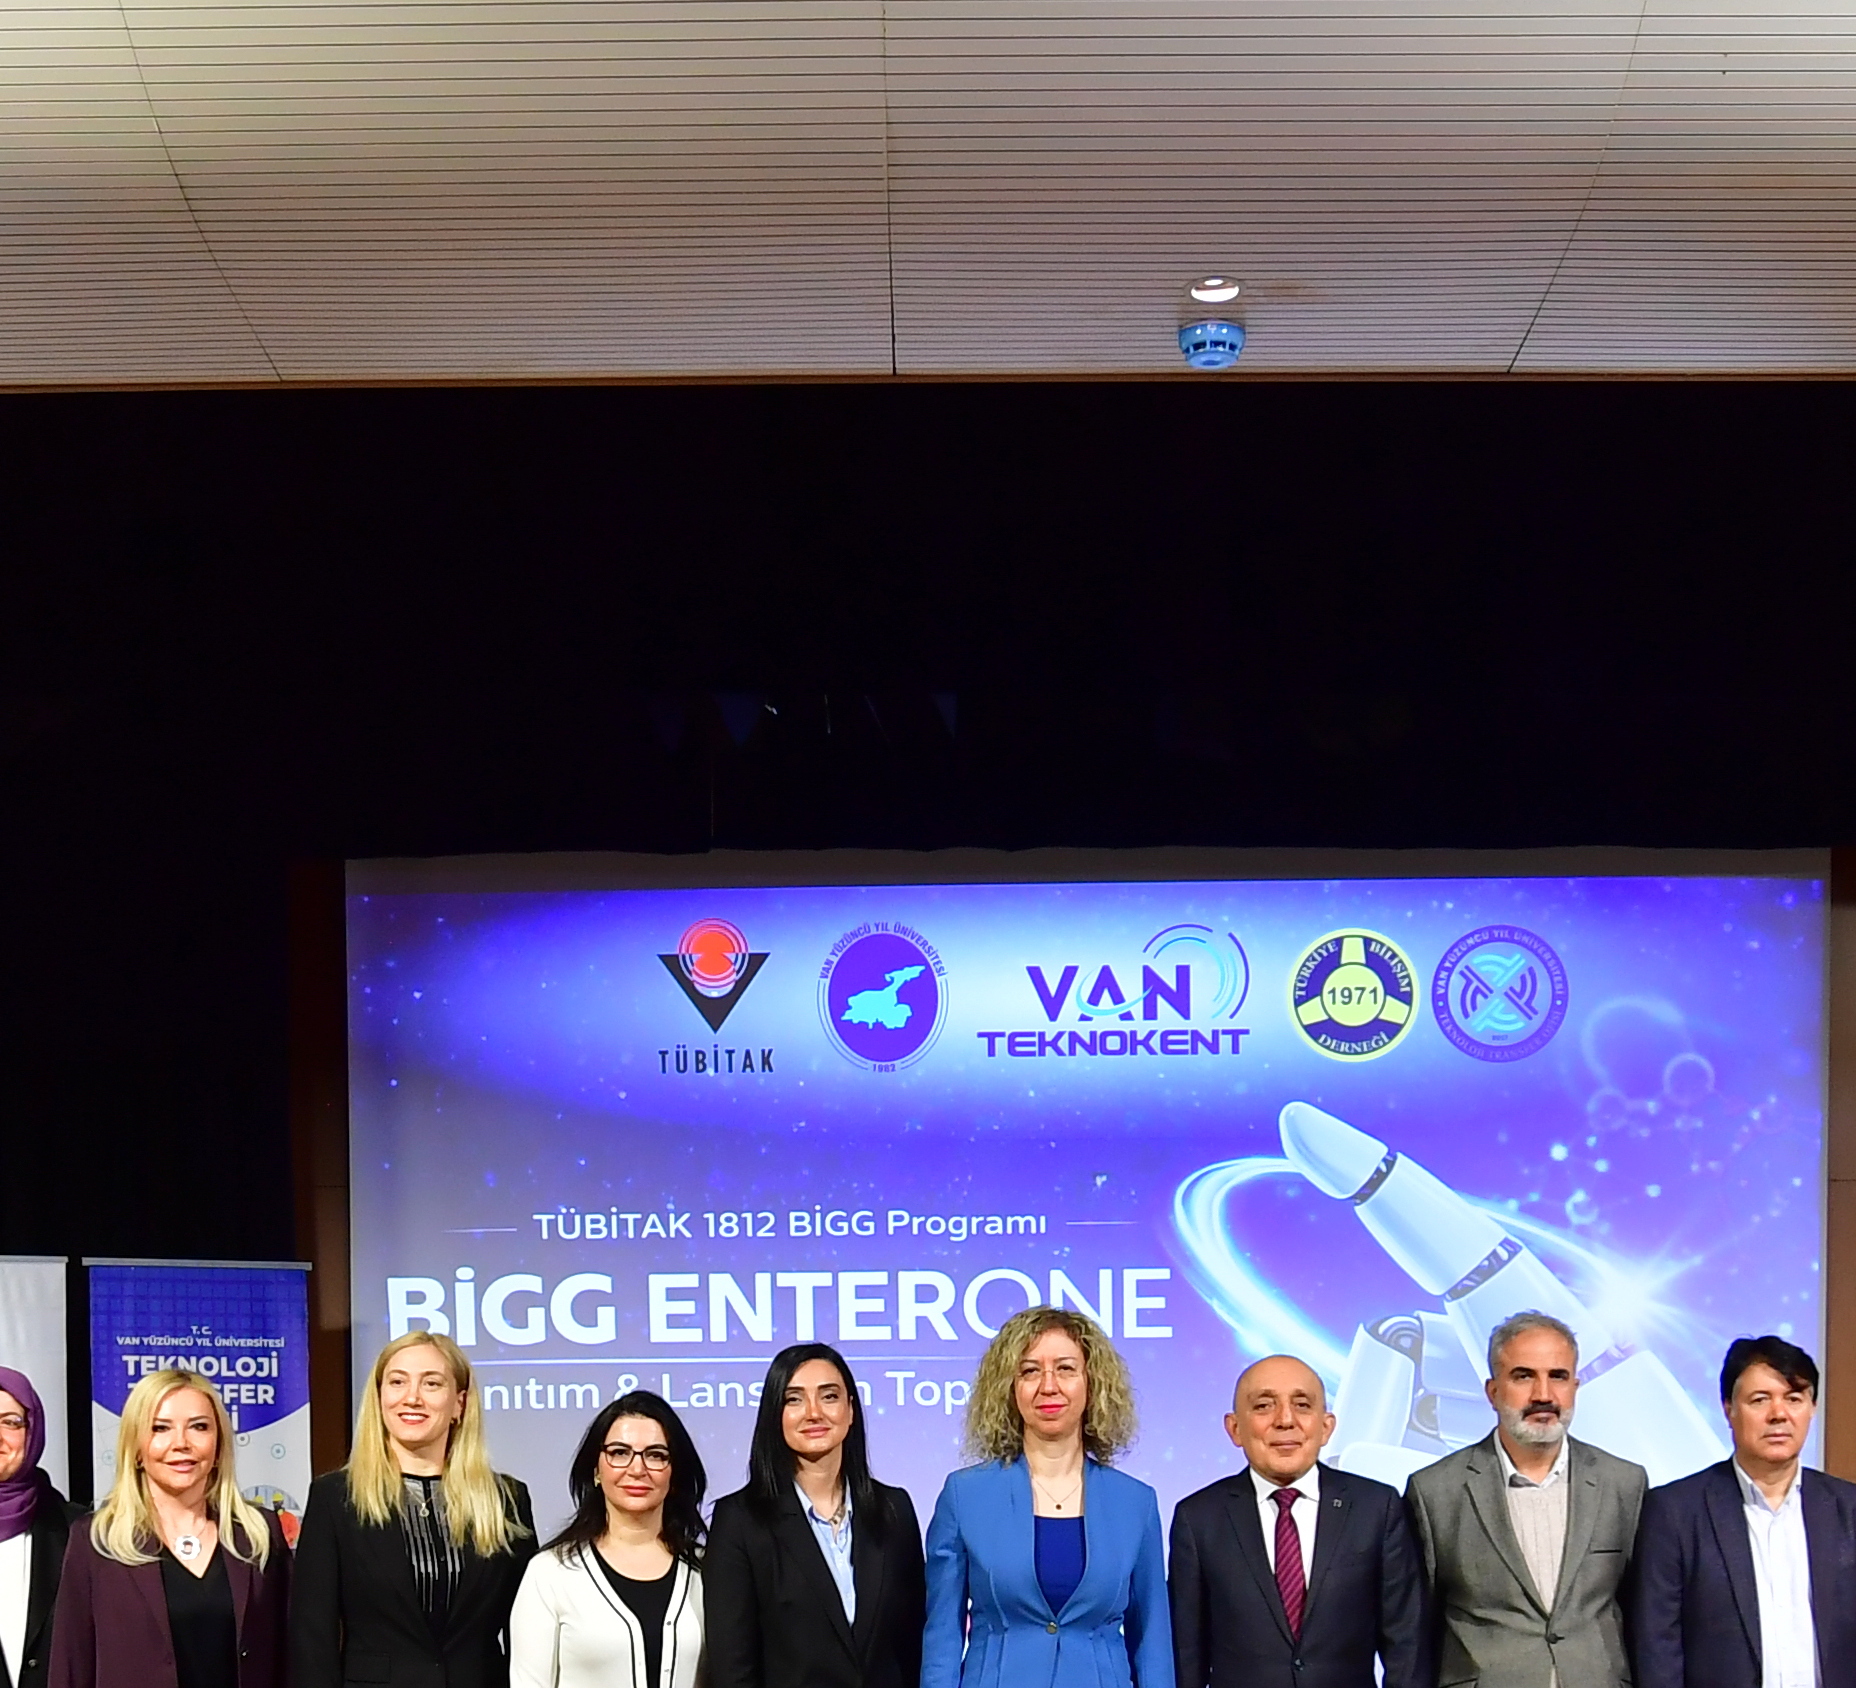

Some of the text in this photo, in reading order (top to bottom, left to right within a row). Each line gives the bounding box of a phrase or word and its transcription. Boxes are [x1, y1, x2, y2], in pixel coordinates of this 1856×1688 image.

[819, 958, 834, 979] VAN
[874, 922, 890, 932] YIL
[1025, 964, 1191, 1022] VAN
[1327, 986, 1378, 1005] 1971
[658, 1043, 774, 1074] TÜBİTAK
[977, 1029, 1250, 1057] TEKNOKENT
[532, 1205, 1047, 1242] TÜBİTAK 1812 BİGG Programı
[386, 1266, 1173, 1346] BİGG ENTERONE
[116, 1334, 285, 1348] VAN YÜZÜNCÜ YIL ÜNİVERSİTESİ
